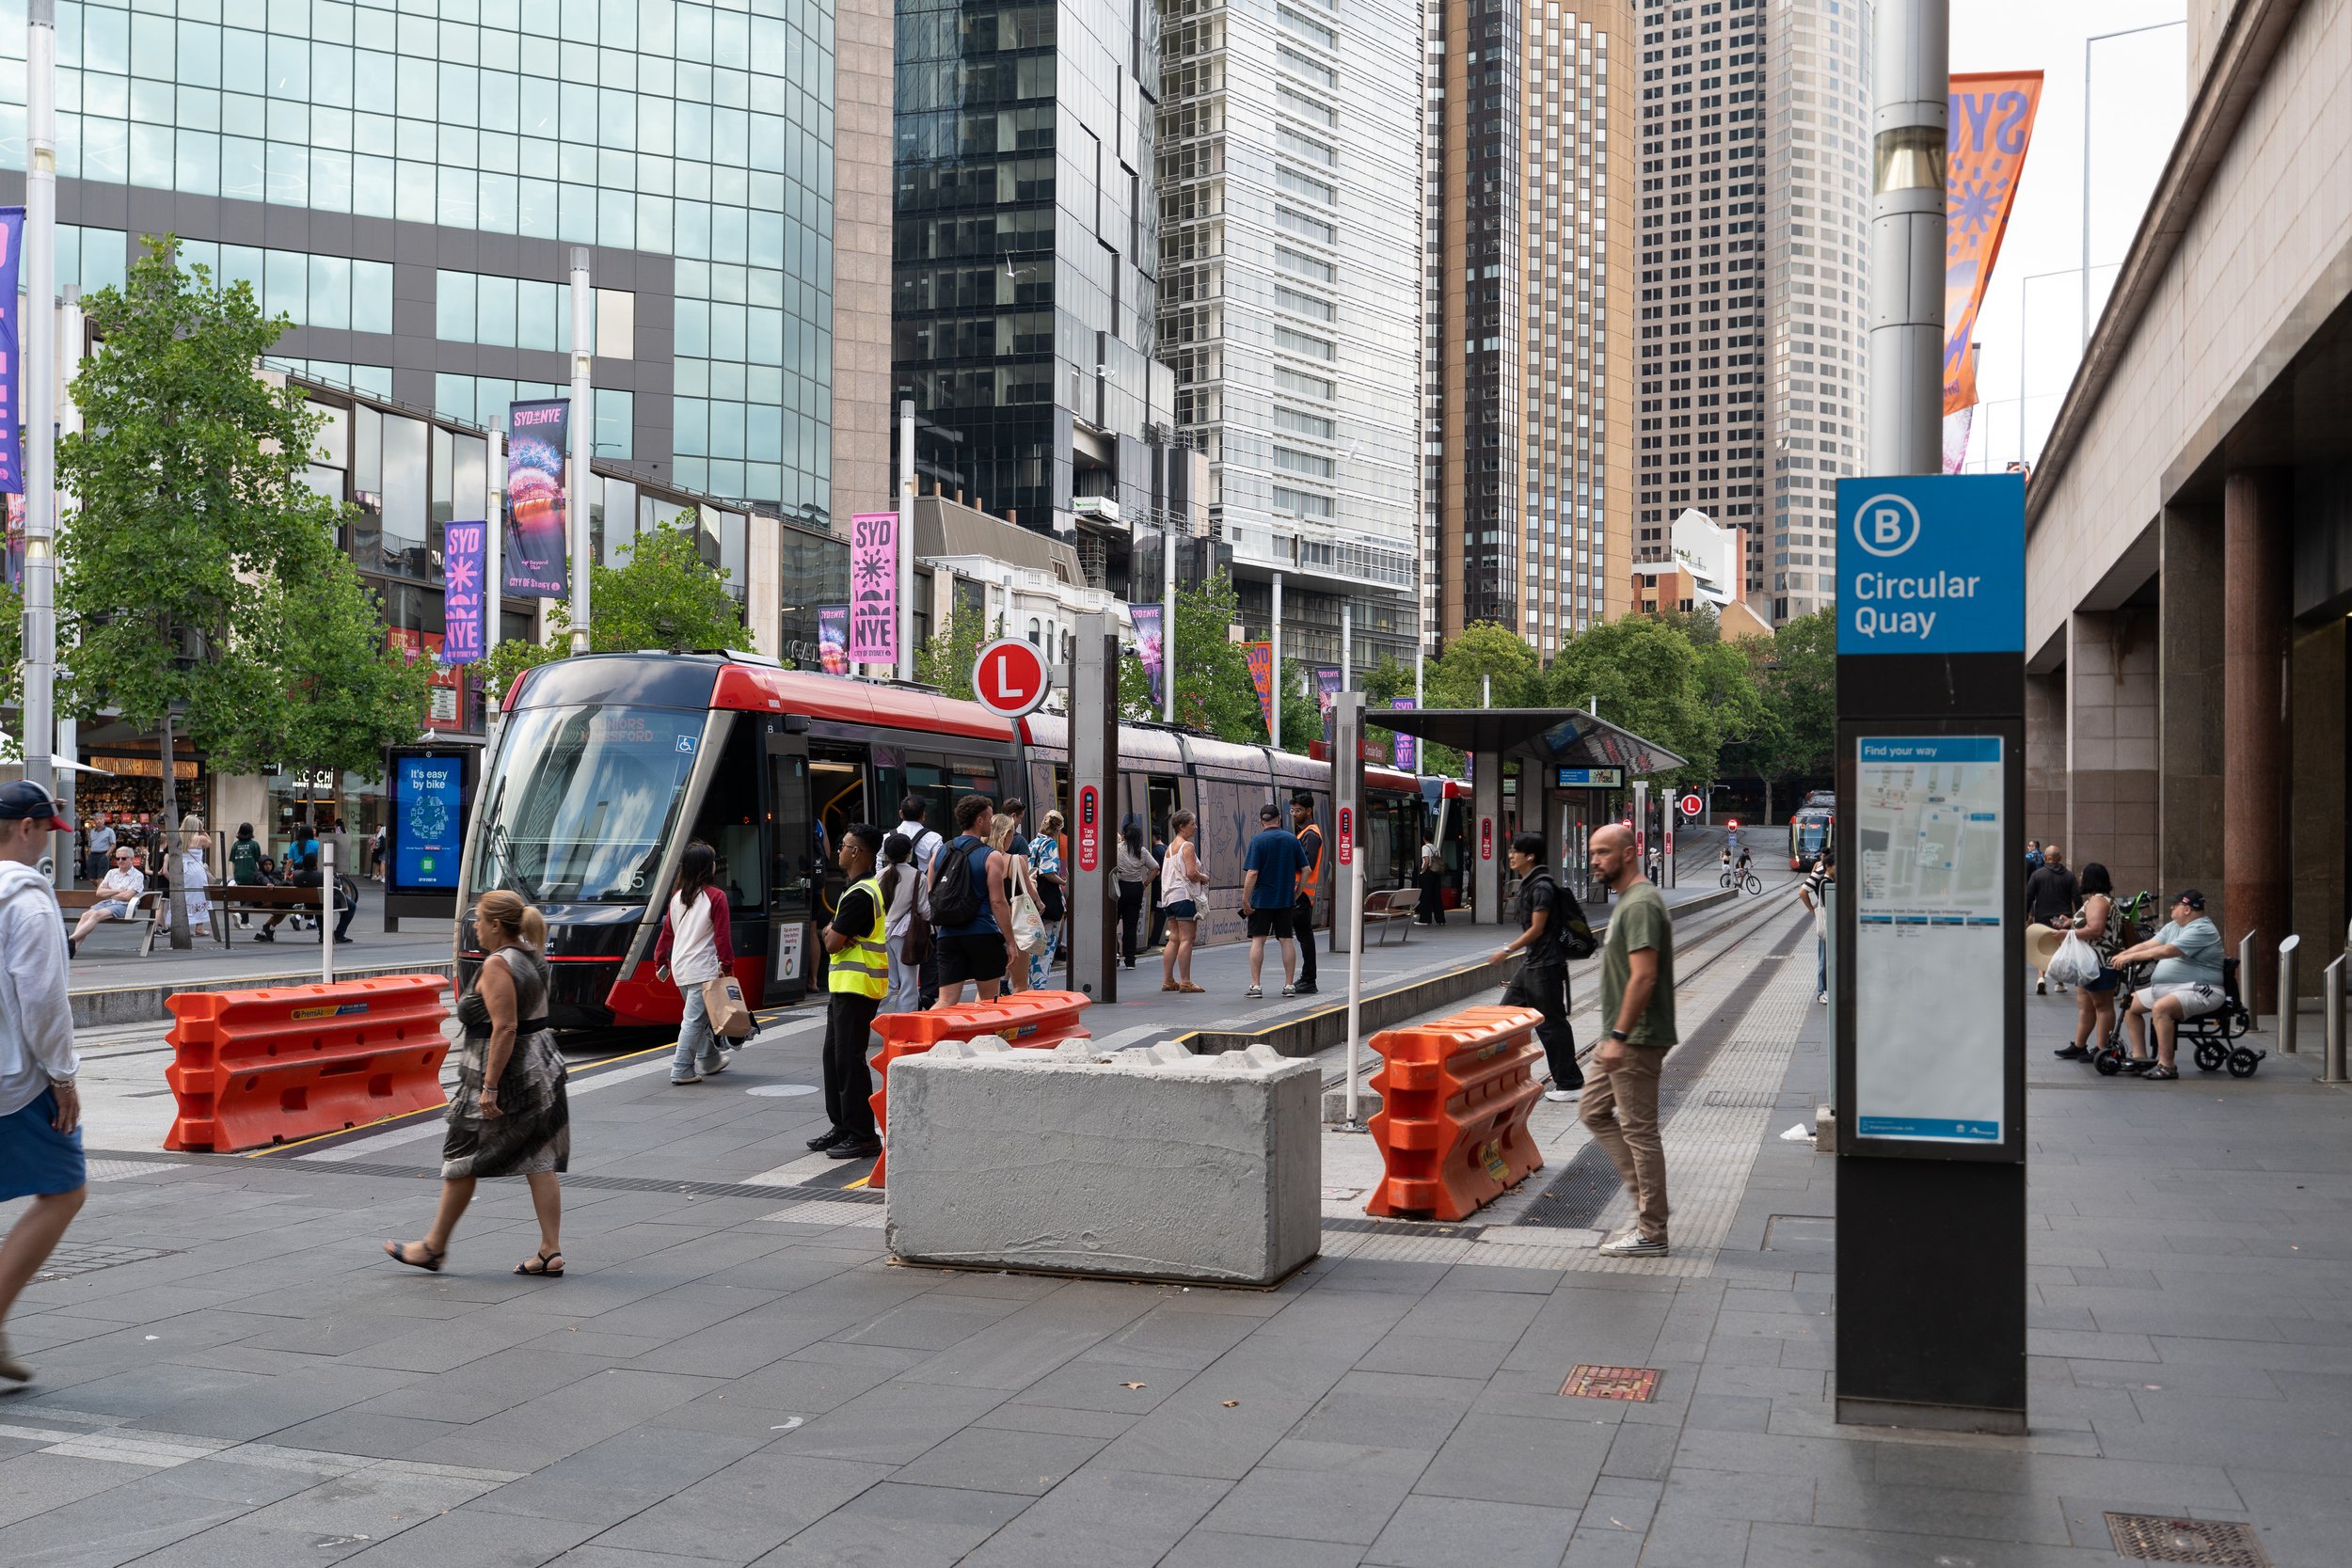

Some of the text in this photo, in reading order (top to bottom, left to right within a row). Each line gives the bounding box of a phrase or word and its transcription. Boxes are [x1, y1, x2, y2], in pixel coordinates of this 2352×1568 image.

[514, 408, 562, 427] SYD NYE
[856, 520, 891, 548] SYD
[1875, 509, 1901, 544] B
[448, 528, 480, 555] SYD
[509, 578, 523, 587] CITY
[523, 578, 531, 587] OF
[1855, 570, 1980, 600] Circular
[1855, 607, 1936, 640] Quay
[390, 632, 408, 647] UFC
[446, 622, 478, 648] NYE
[855, 619, 891, 647] NYE
[997, 656, 1024, 698] L
[767, 724, 774, 734] B
[1864, 746, 1938, 757] Find your way
[96, 756, 134, 774] SOUVENIRS
[411, 769, 448, 781] It's easy
[412, 780, 445, 790] by bike
[1688, 800, 1695, 811] L
[618, 870, 645, 888] 05
